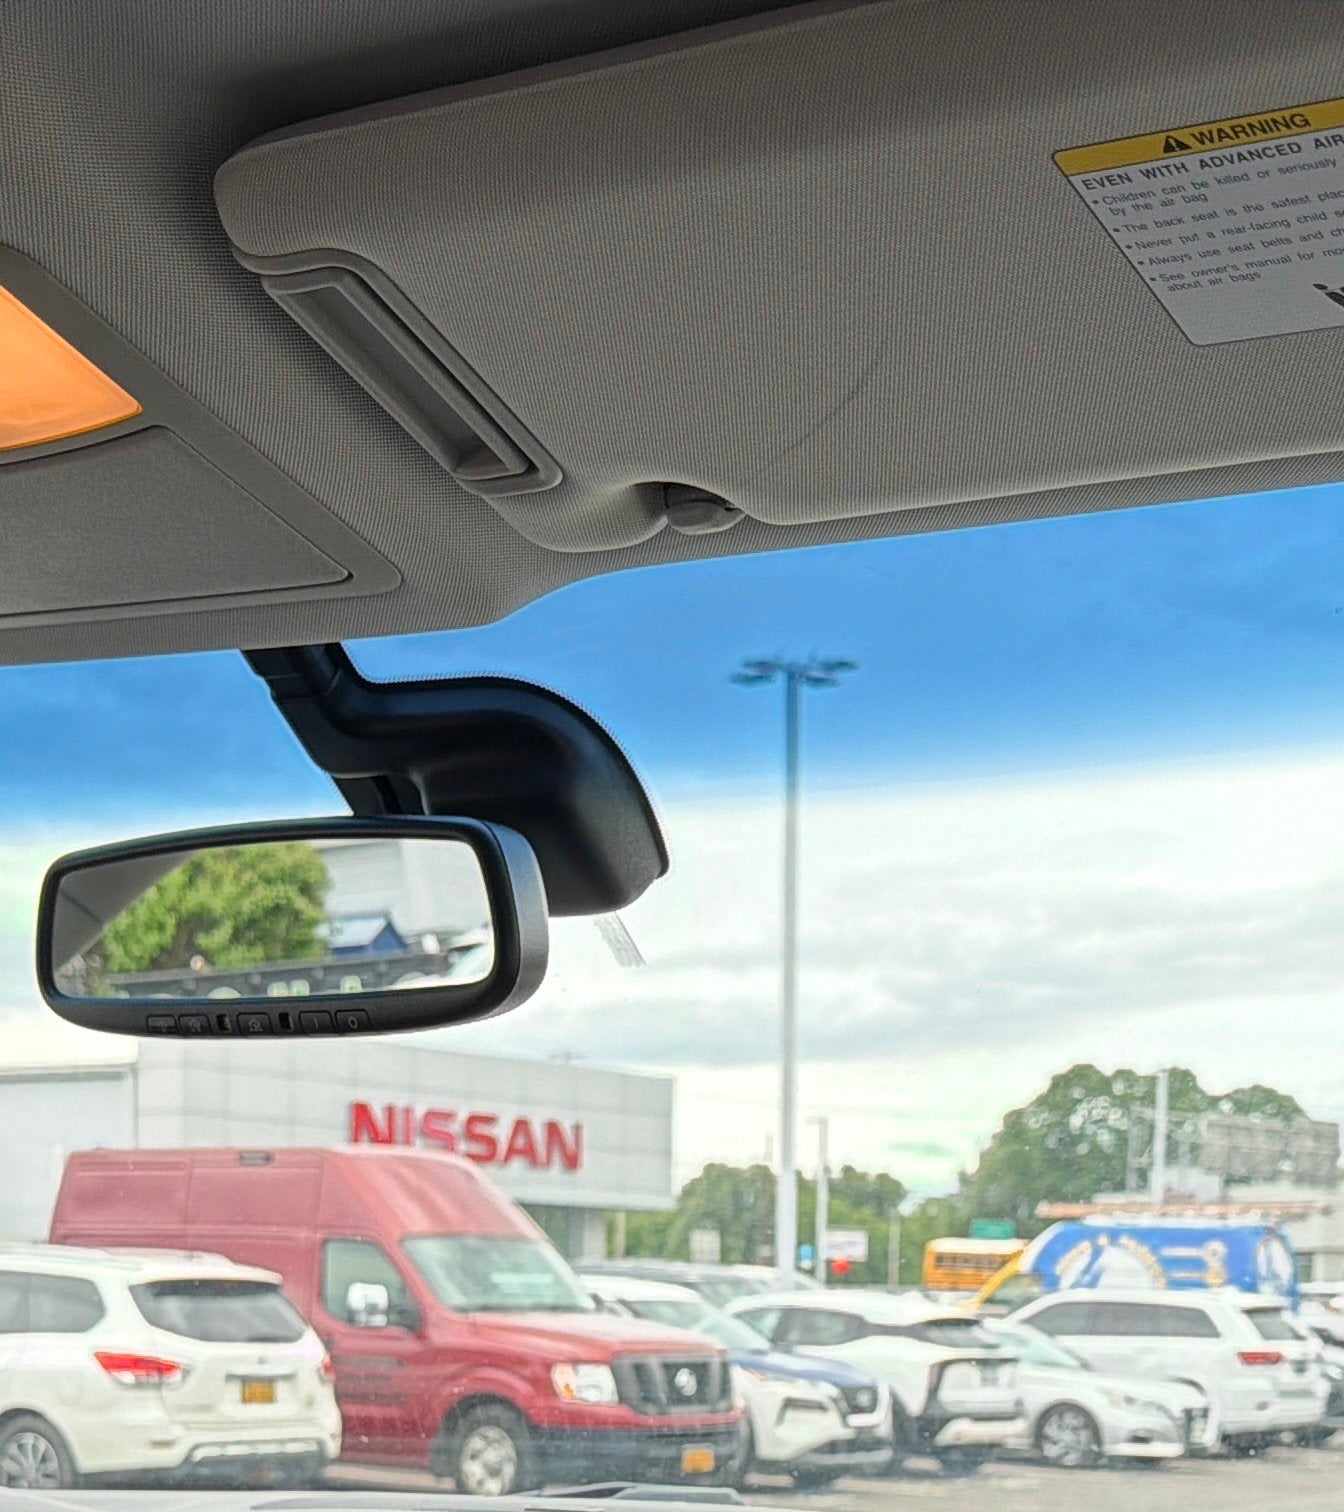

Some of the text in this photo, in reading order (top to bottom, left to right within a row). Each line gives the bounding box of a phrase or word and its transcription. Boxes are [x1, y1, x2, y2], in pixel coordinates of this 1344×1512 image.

[1188, 111, 1313, 147] WARNING
[1079, 171, 1135, 191] EVEN
[1137, 161, 1191, 180] WITH
[1194, 140, 1305, 170] ADVANCED
[1099, 187, 1158, 206] Children
[1159, 184, 1188, 195] can
[1129, 201, 1155, 212] the
[1157, 198, 1178, 207] air
[1179, 192, 1210, 205] bag
[1120, 221, 1150, 233] The
[1151, 216, 1187, 228] back
[1189, 210, 1221, 222] seat
[1240, 202, 1266, 213] the
[1133, 237, 1175, 250] Never
[1176, 233, 1202, 244] put
[1293, 211, 1330, 224] child
[1145, 252, 1194, 266] Always
[1195, 248, 1223, 258] use
[1225, 242, 1257, 253] seat
[1296, 231, 1326, 242] and
[1157, 271, 1187, 282] See
[1242, 255, 1294, 269] manual
[1295, 250, 1317, 261] for
[351, 1101, 584, 1171] NISSAN
